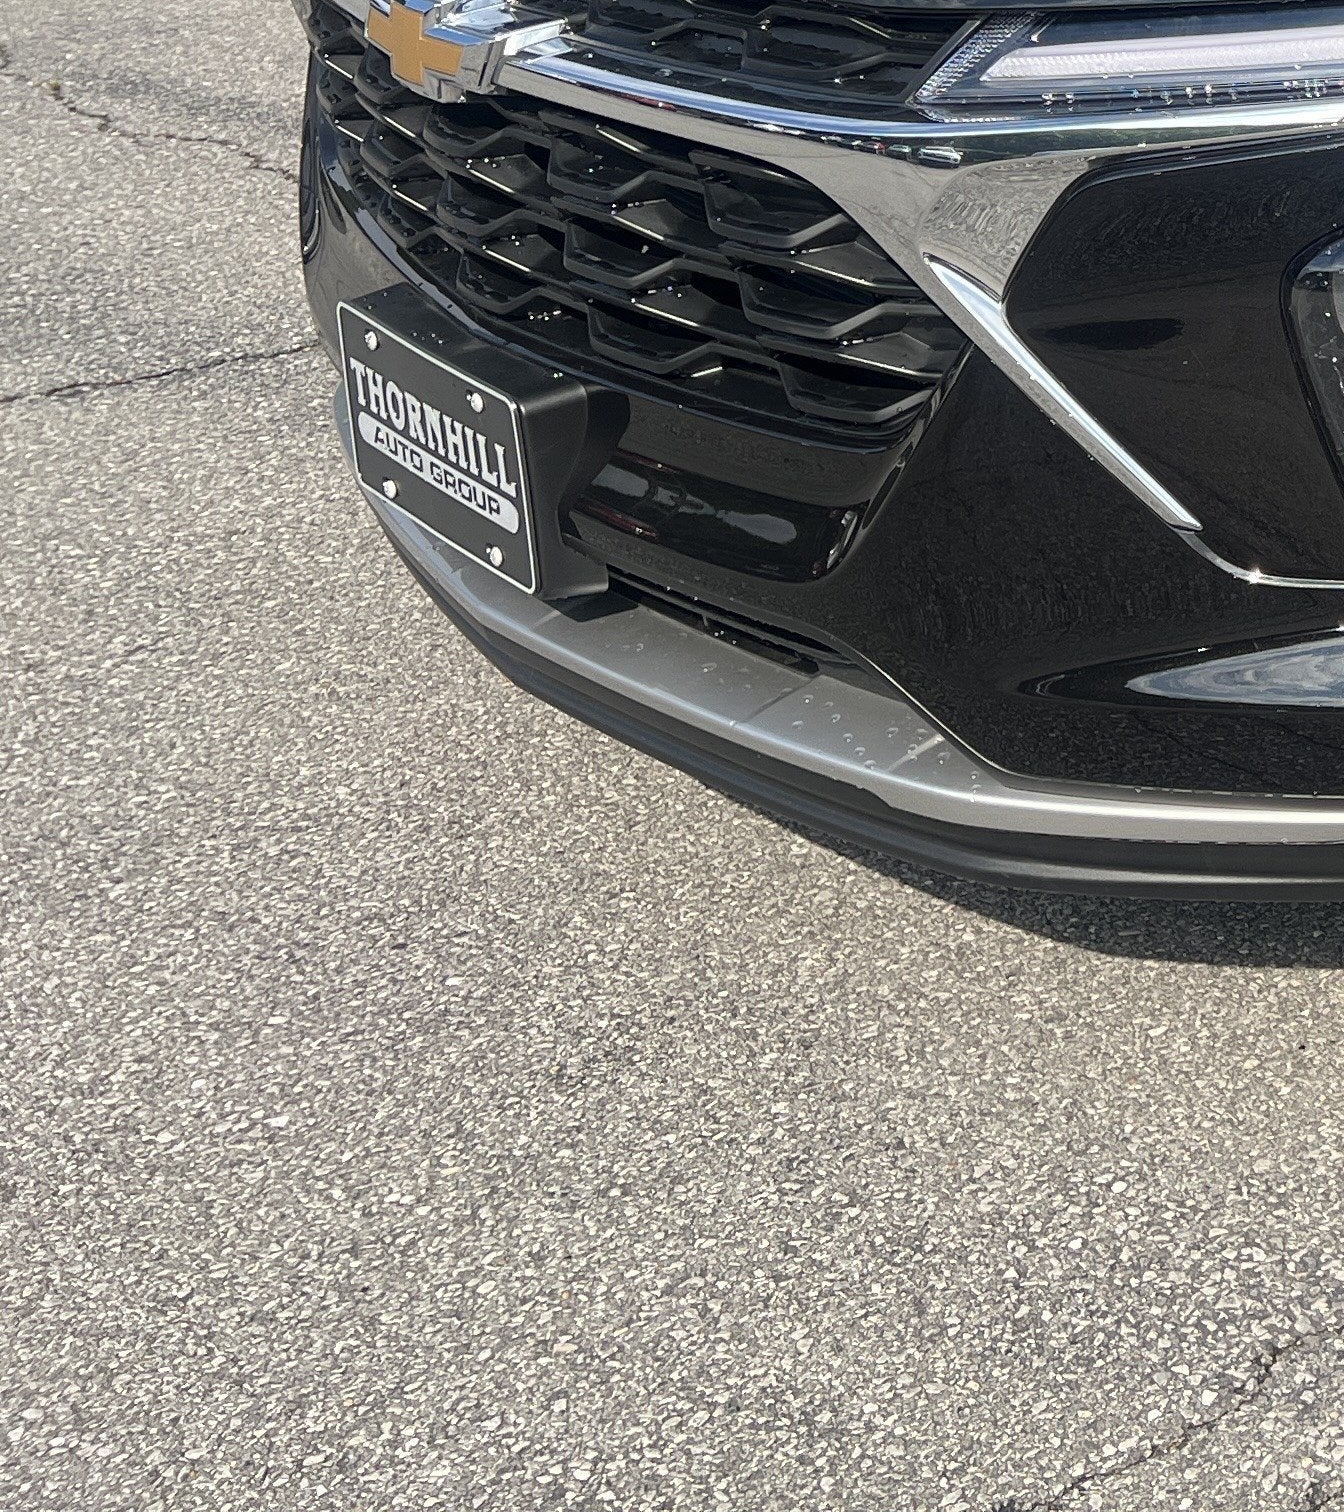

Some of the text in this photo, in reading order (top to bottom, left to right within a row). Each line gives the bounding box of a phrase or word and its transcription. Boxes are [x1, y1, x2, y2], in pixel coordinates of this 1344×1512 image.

[350, 356, 517, 498] THORNHILL
[373, 426, 501, 517] AUTO GROUP
